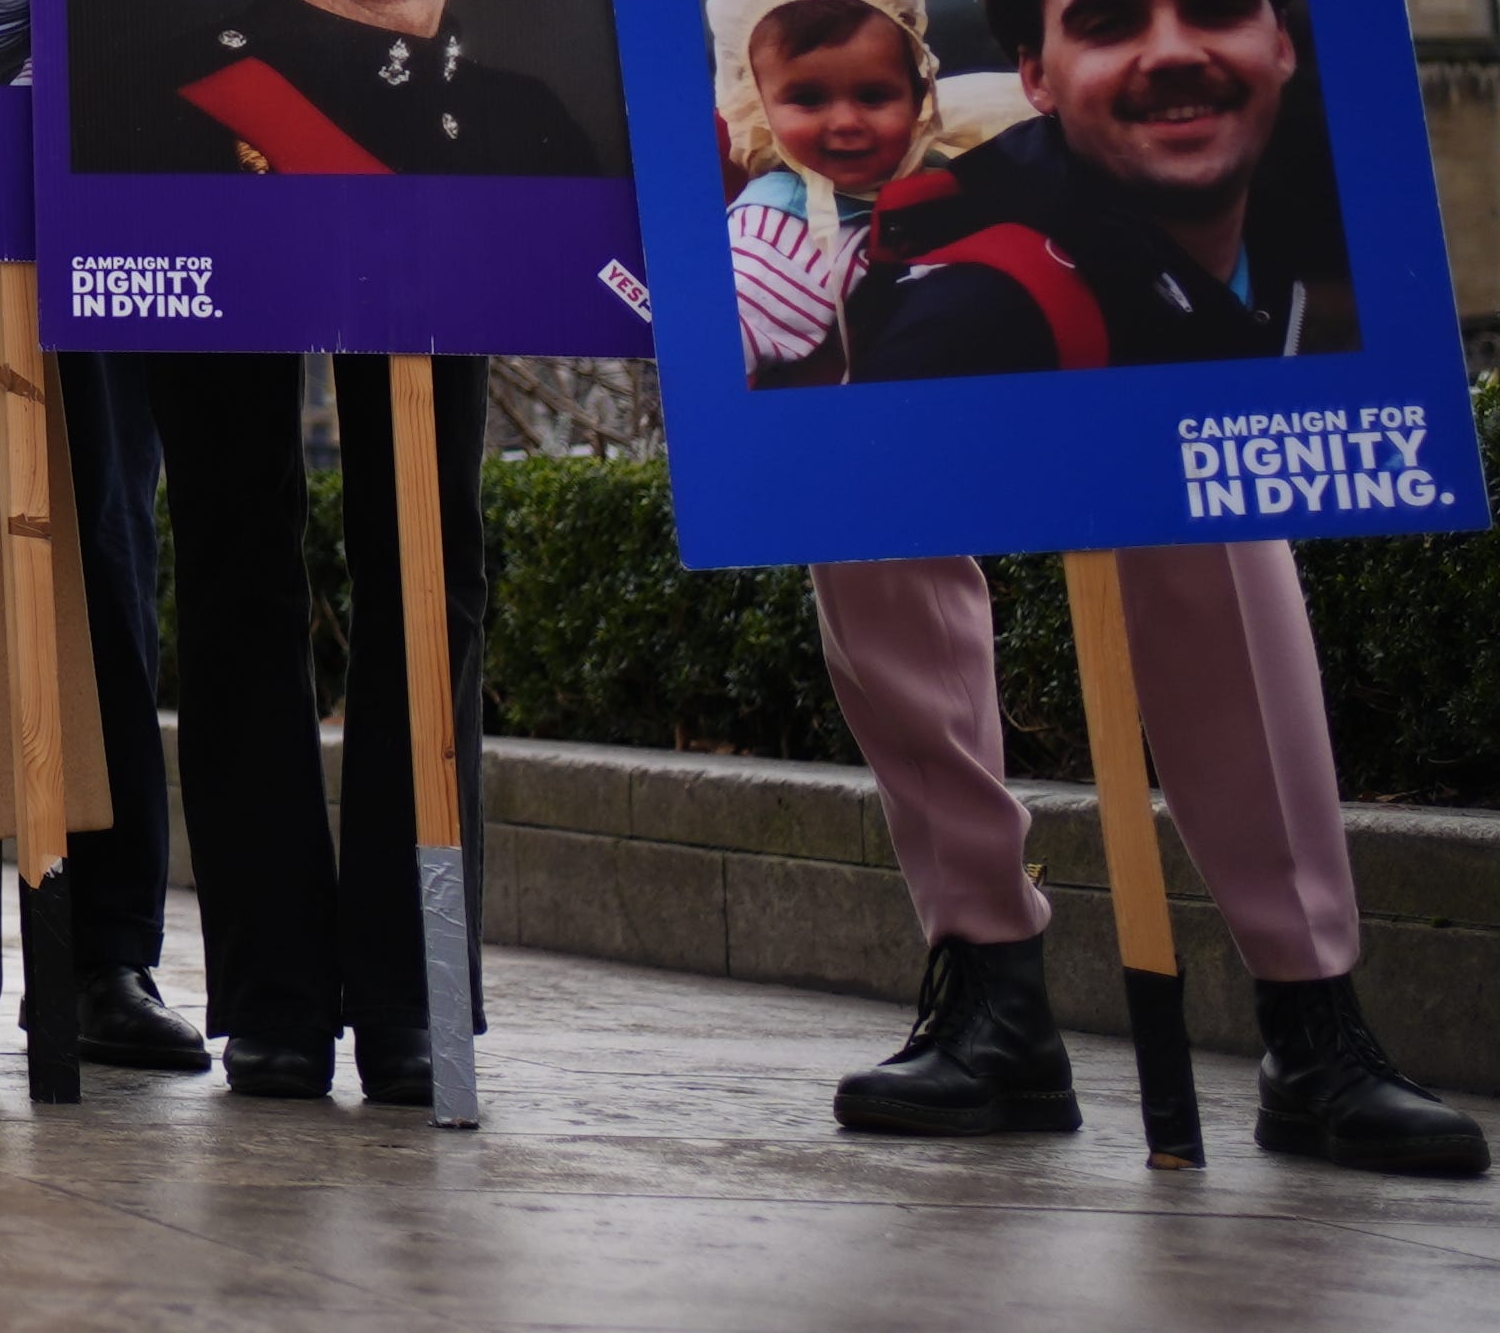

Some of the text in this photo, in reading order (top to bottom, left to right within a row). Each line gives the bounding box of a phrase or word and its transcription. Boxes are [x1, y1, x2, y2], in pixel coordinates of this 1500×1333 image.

[72, 257, 212, 269] CAMPAIGN FOR
[73, 271, 211, 293] DIGNITY
[74, 295, 104, 316] IN
[1179, 407, 1425, 439] CAMPAIGN FOR
[1182, 430, 1426, 478] DIGNITY
[1188, 480, 1245, 517] IN
